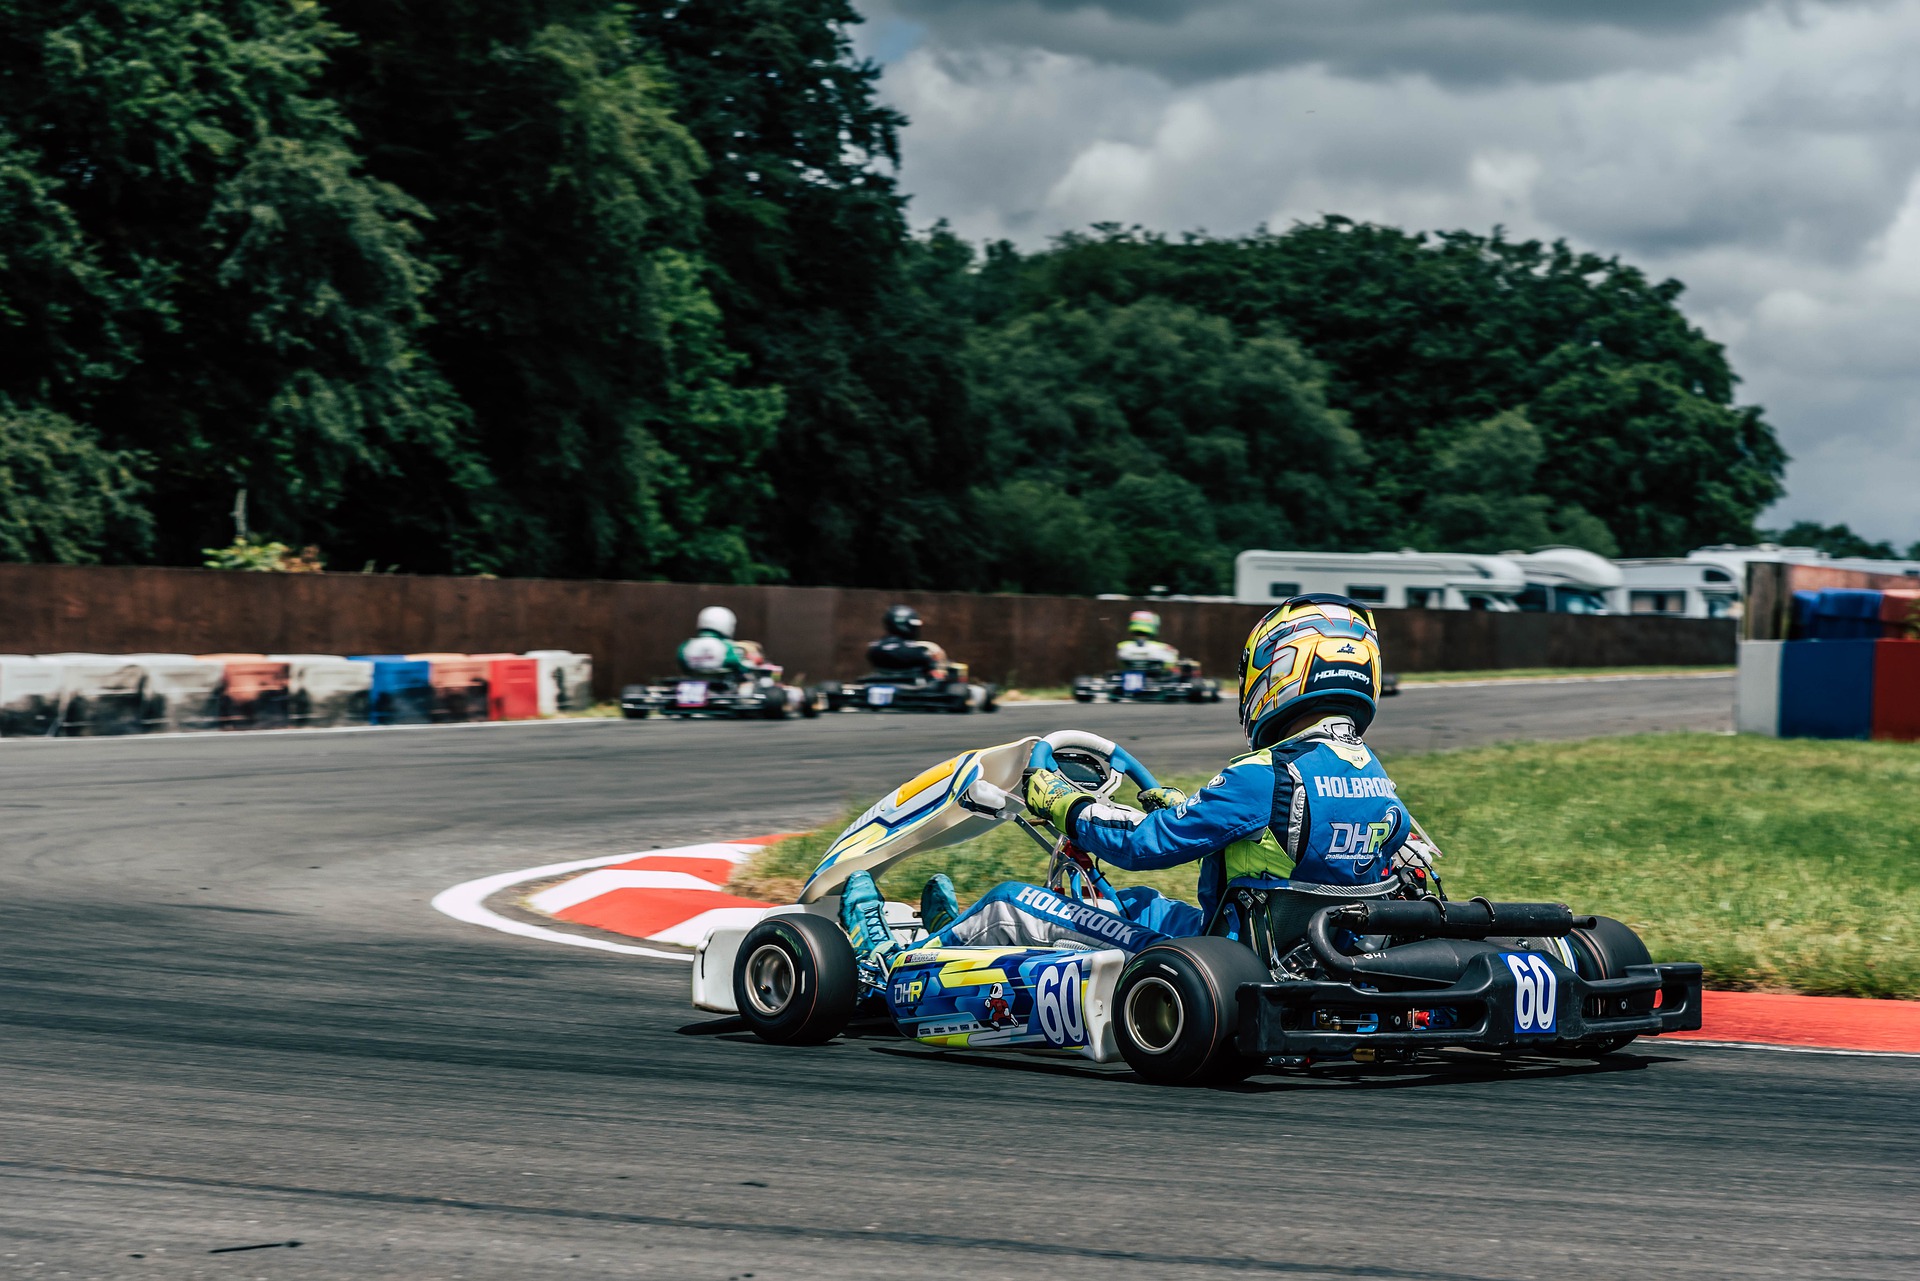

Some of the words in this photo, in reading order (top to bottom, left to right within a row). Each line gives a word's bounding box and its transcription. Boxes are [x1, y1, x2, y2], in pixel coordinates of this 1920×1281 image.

[1313, 669, 1370, 685] HOLBROOK
[1328, 822, 1389, 853] DHR
[1016, 886, 1138, 945] HOLBROOK
[894, 981, 922, 1003] DHR
[1037, 962, 1084, 1044] 60
[1507, 955, 1556, 1029] 60
